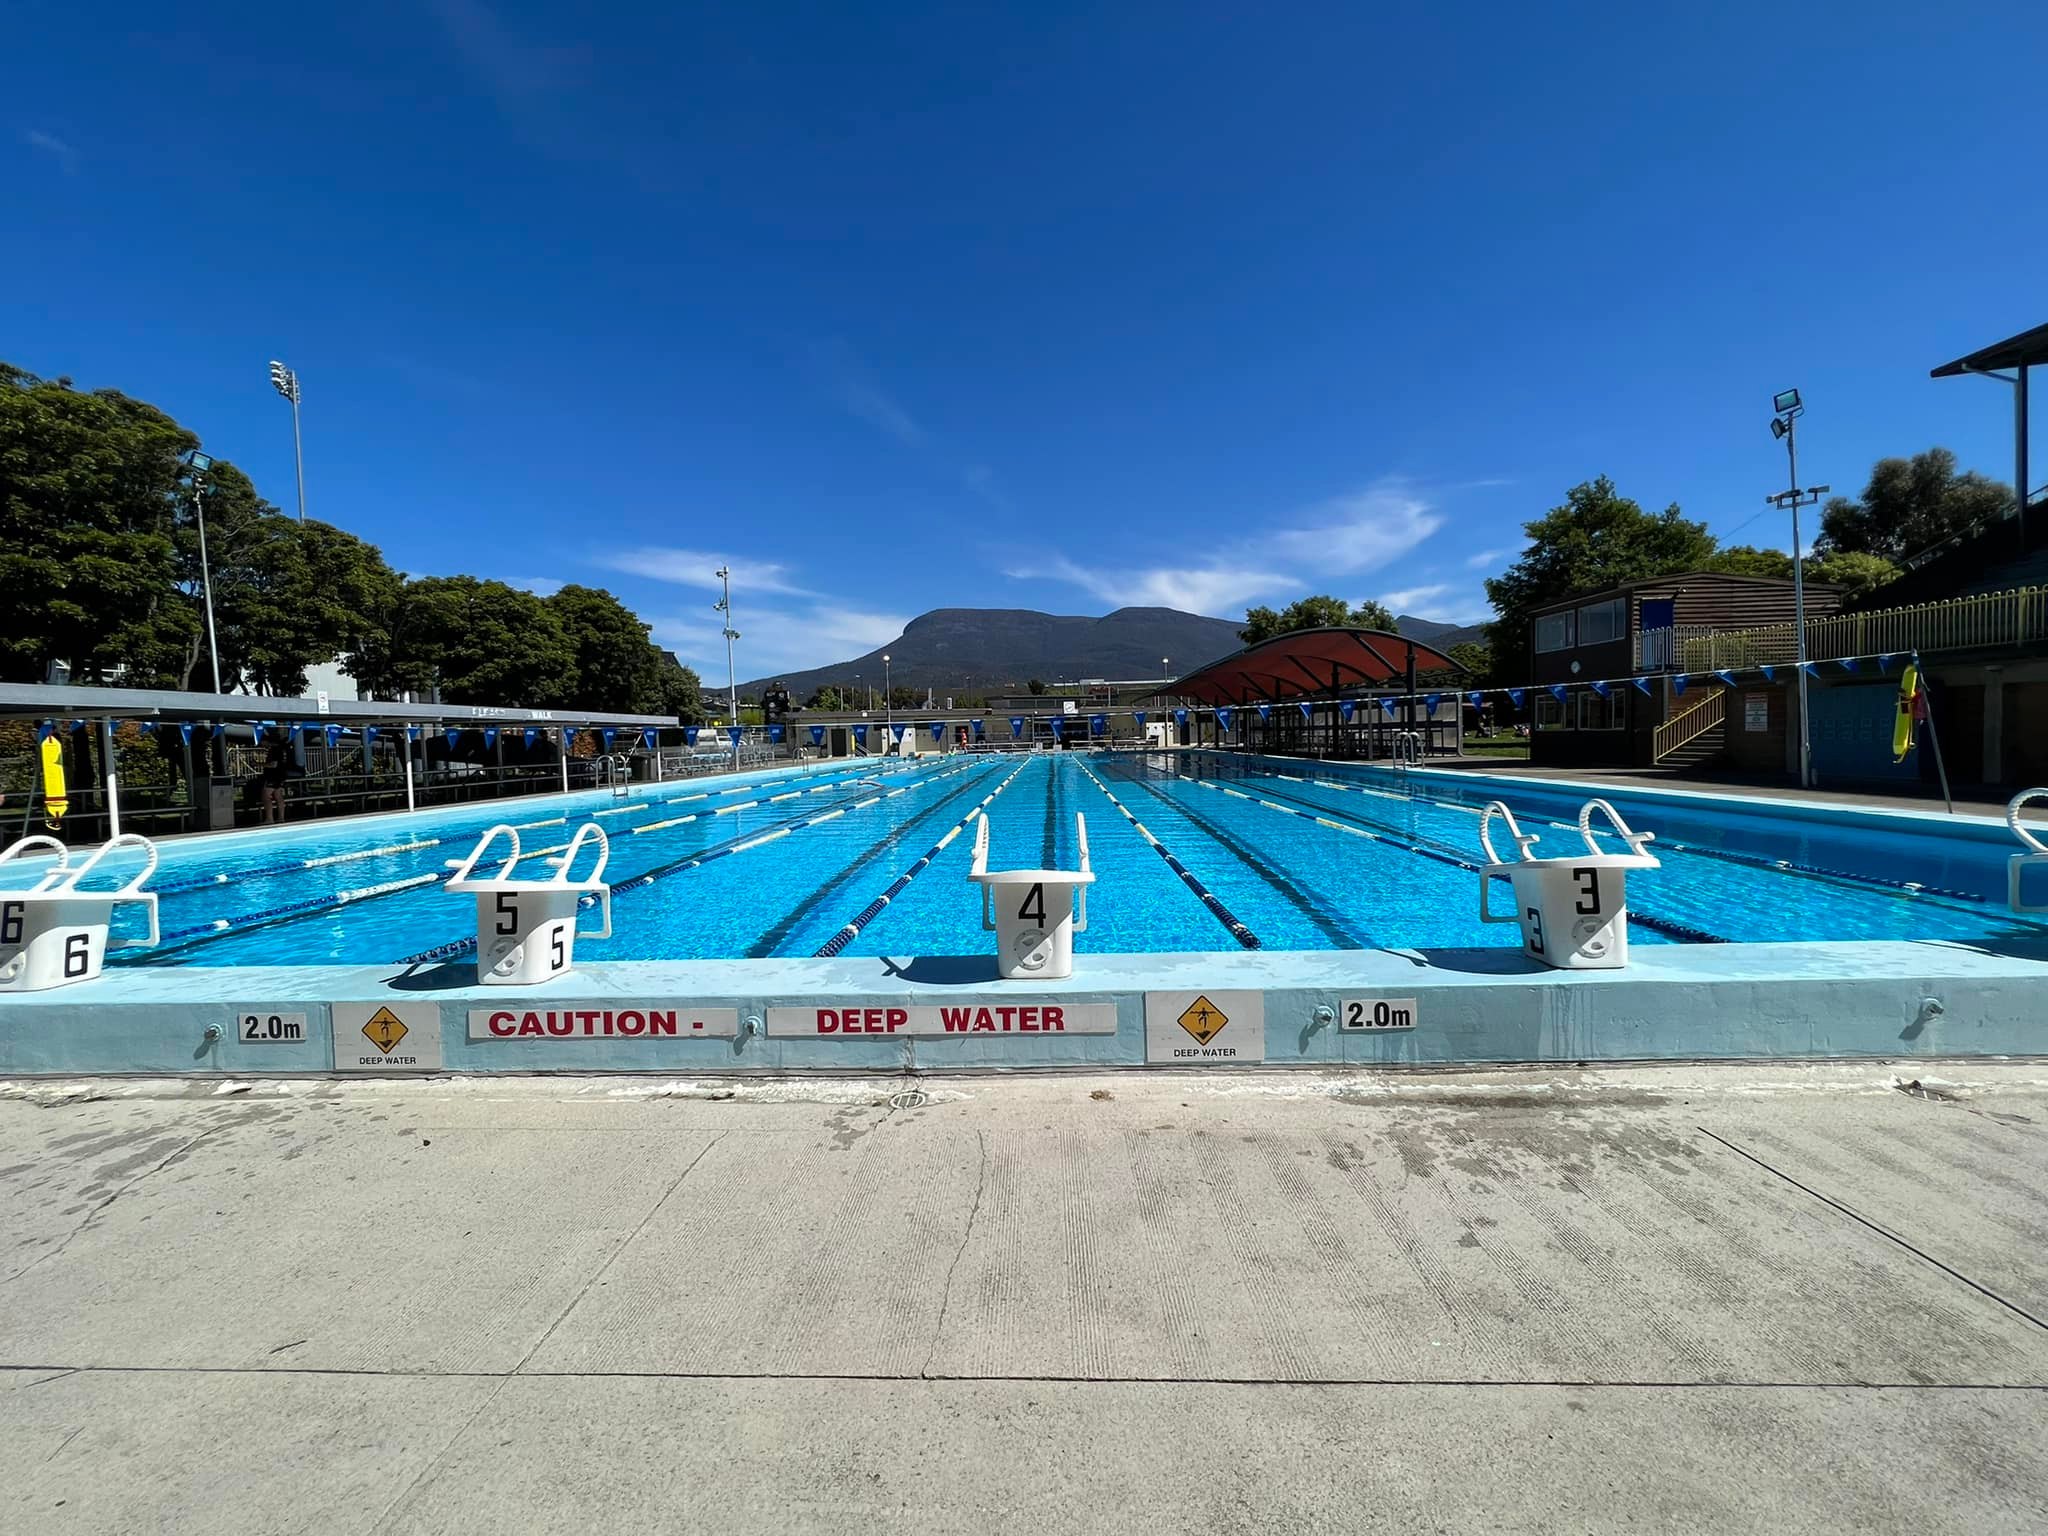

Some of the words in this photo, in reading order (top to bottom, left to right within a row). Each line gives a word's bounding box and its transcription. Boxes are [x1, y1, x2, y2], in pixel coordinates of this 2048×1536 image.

[1018, 882, 1046, 928] 4
[1573, 867, 1600, 914] 3
[1, 900, 24, 944] 6
[496, 891, 518, 935] 5
[1527, 907, 1544, 955] 3
[64, 933, 89, 978] 6
[551, 925, 564, 970] 5
[245, 1015, 300, 1039] 2.0m
[488, 1010, 677, 1036] CAUTION
[816, 1008, 908, 1033] DEEP
[940, 1006, 1065, 1032] WATER
[1347, 1002, 1411, 1027] 2.0m
[359, 1056, 383, 1065] DEEP
[384, 1056, 417, 1065] WATER
[1173, 1049, 1200, 1057] DEEP
[1201, 1048, 1237, 1057] WATER
